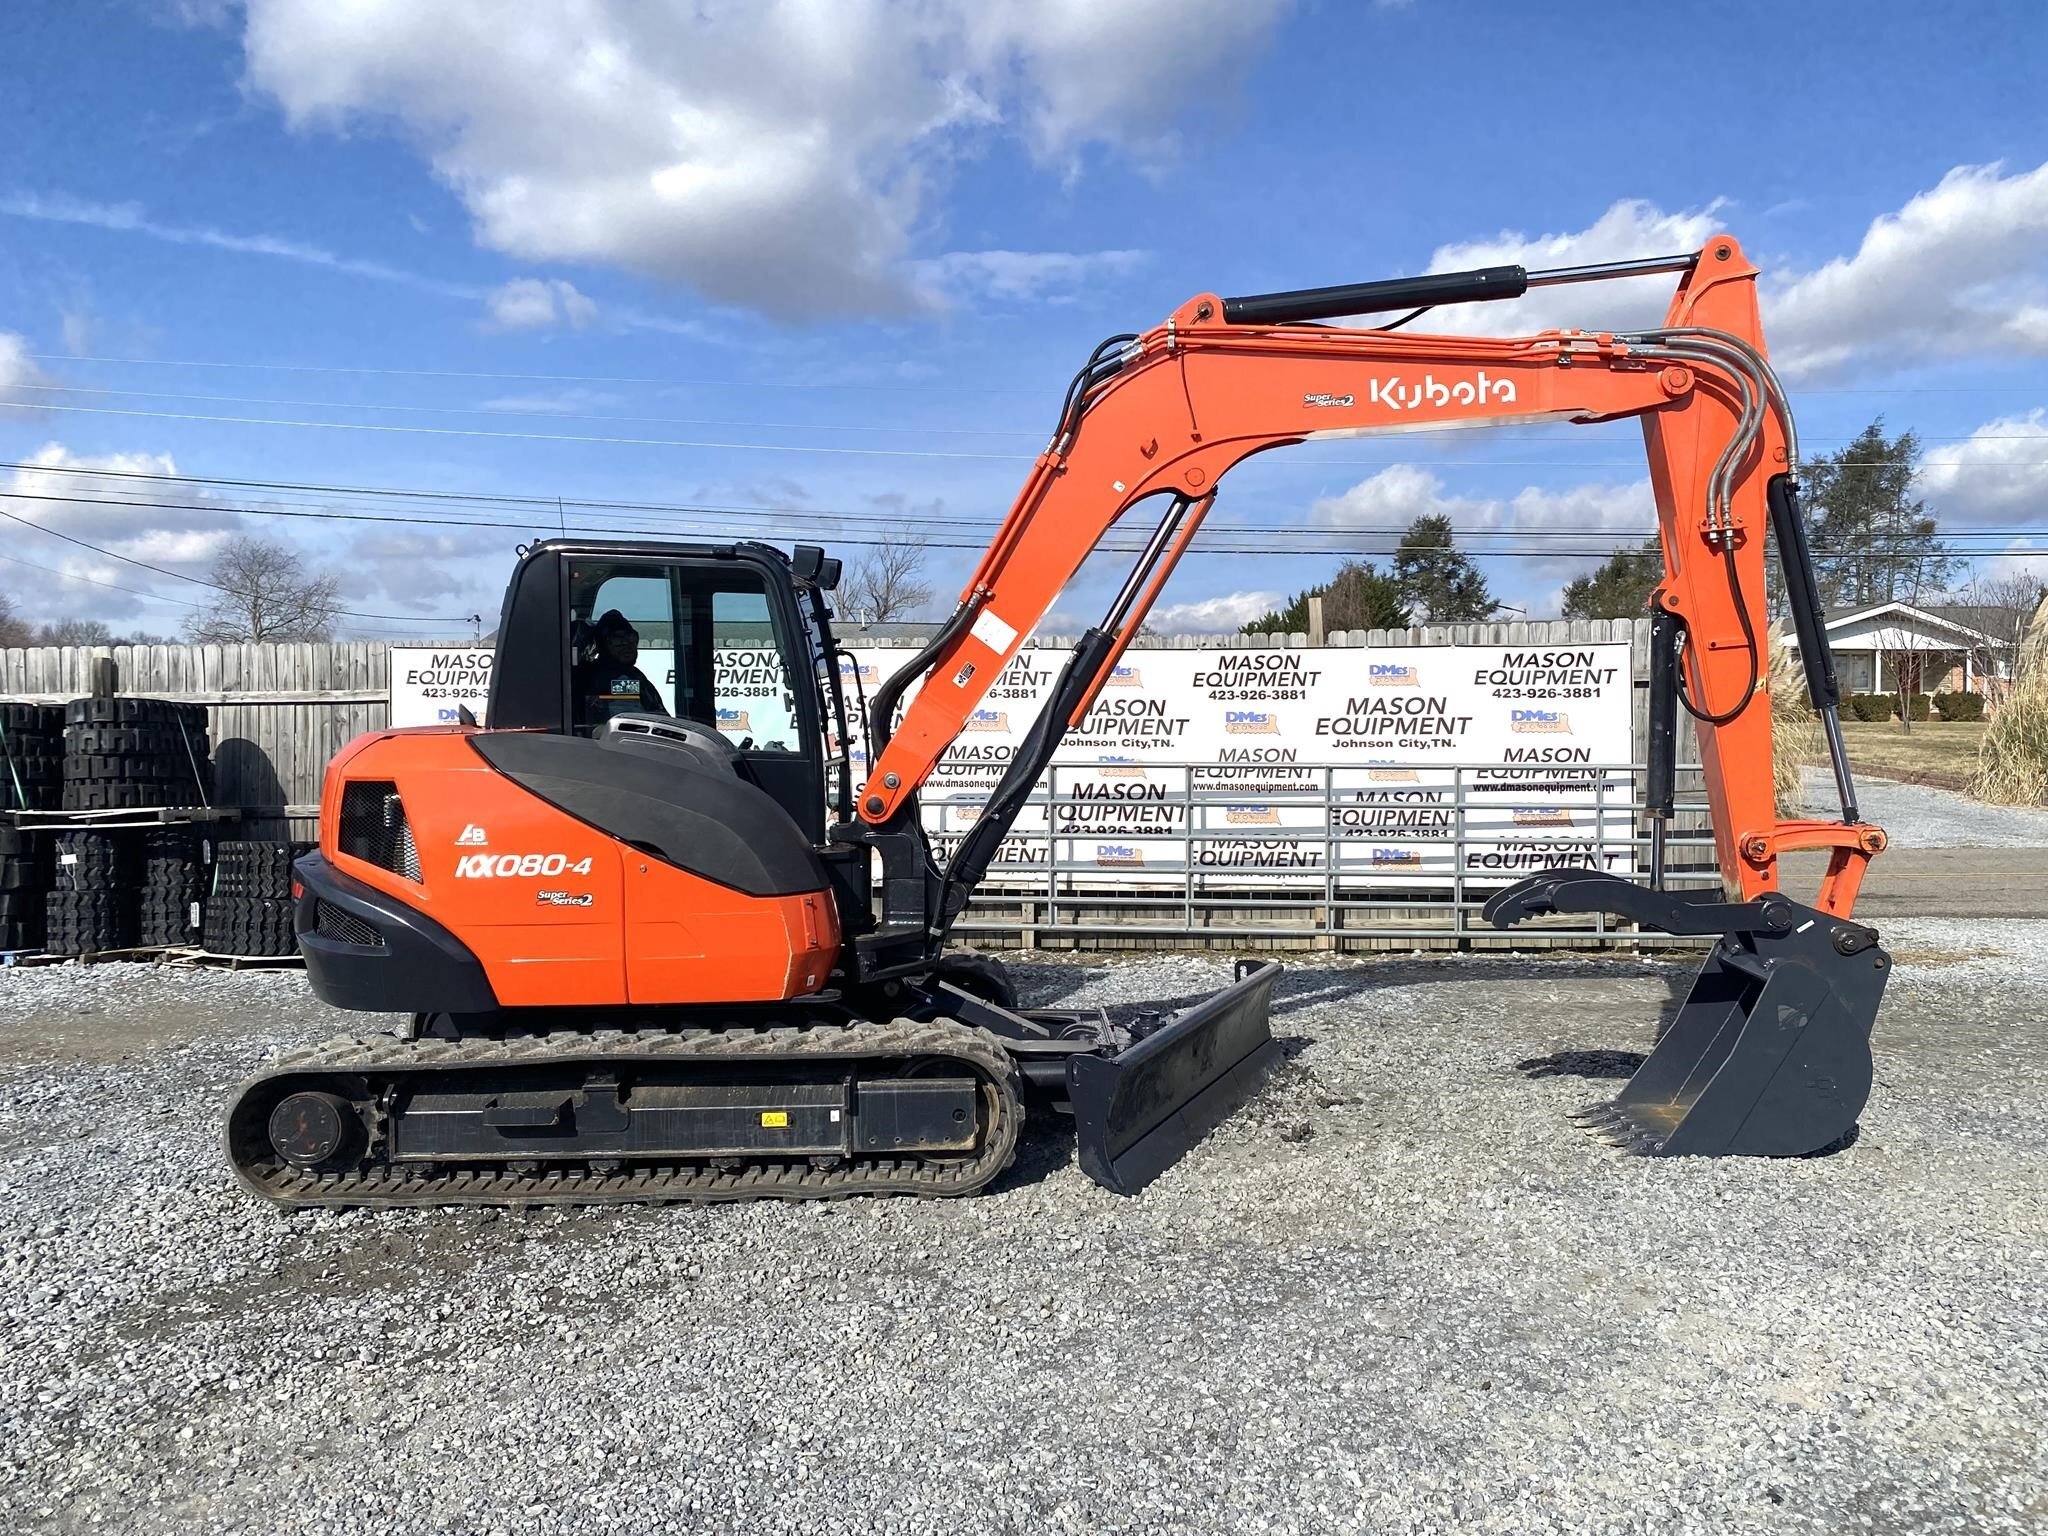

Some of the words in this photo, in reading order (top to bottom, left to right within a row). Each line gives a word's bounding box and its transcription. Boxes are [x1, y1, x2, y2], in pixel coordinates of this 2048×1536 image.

[1304, 393, 1331, 402] Super
[1370, 371, 1517, 409] Kubota
[431, 654, 493, 669] MASO
[714, 652, 772, 668] ASON
[1218, 655, 1301, 670] MASON
[1502, 652, 1594, 668] MASON
[406, 670, 488, 685] EQUIPM
[1193, 672, 1321, 687] EQUIPMENT
[1474, 669, 1618, 685] EQUIPMENT
[422, 688, 489, 698] 423-926-3
[714, 687, 777, 697] 926-3881
[989, 689, 1037, 698] 6-3881
[1208, 690, 1306, 700] 423-926-3881
[1492, 687, 1601, 698] 423-926-3881
[1346, 697, 1447, 715] MASON
[1067, 718, 1190, 735] UIPMENT
[1315, 717, 1473, 735] EQUIPMENT
[1060, 738, 1116, 747] Johnson
[1332, 739, 1393, 748] Johnson
[1218, 748, 1297, 762] MASON
[1504, 748, 1591, 762] MASON
[1071, 783, 1166, 800] MASON
[1193, 781, 1319, 793] www.dmasonequipment.com
[455, 854, 592, 878] KX080-4
[537, 890, 569, 900] Super
